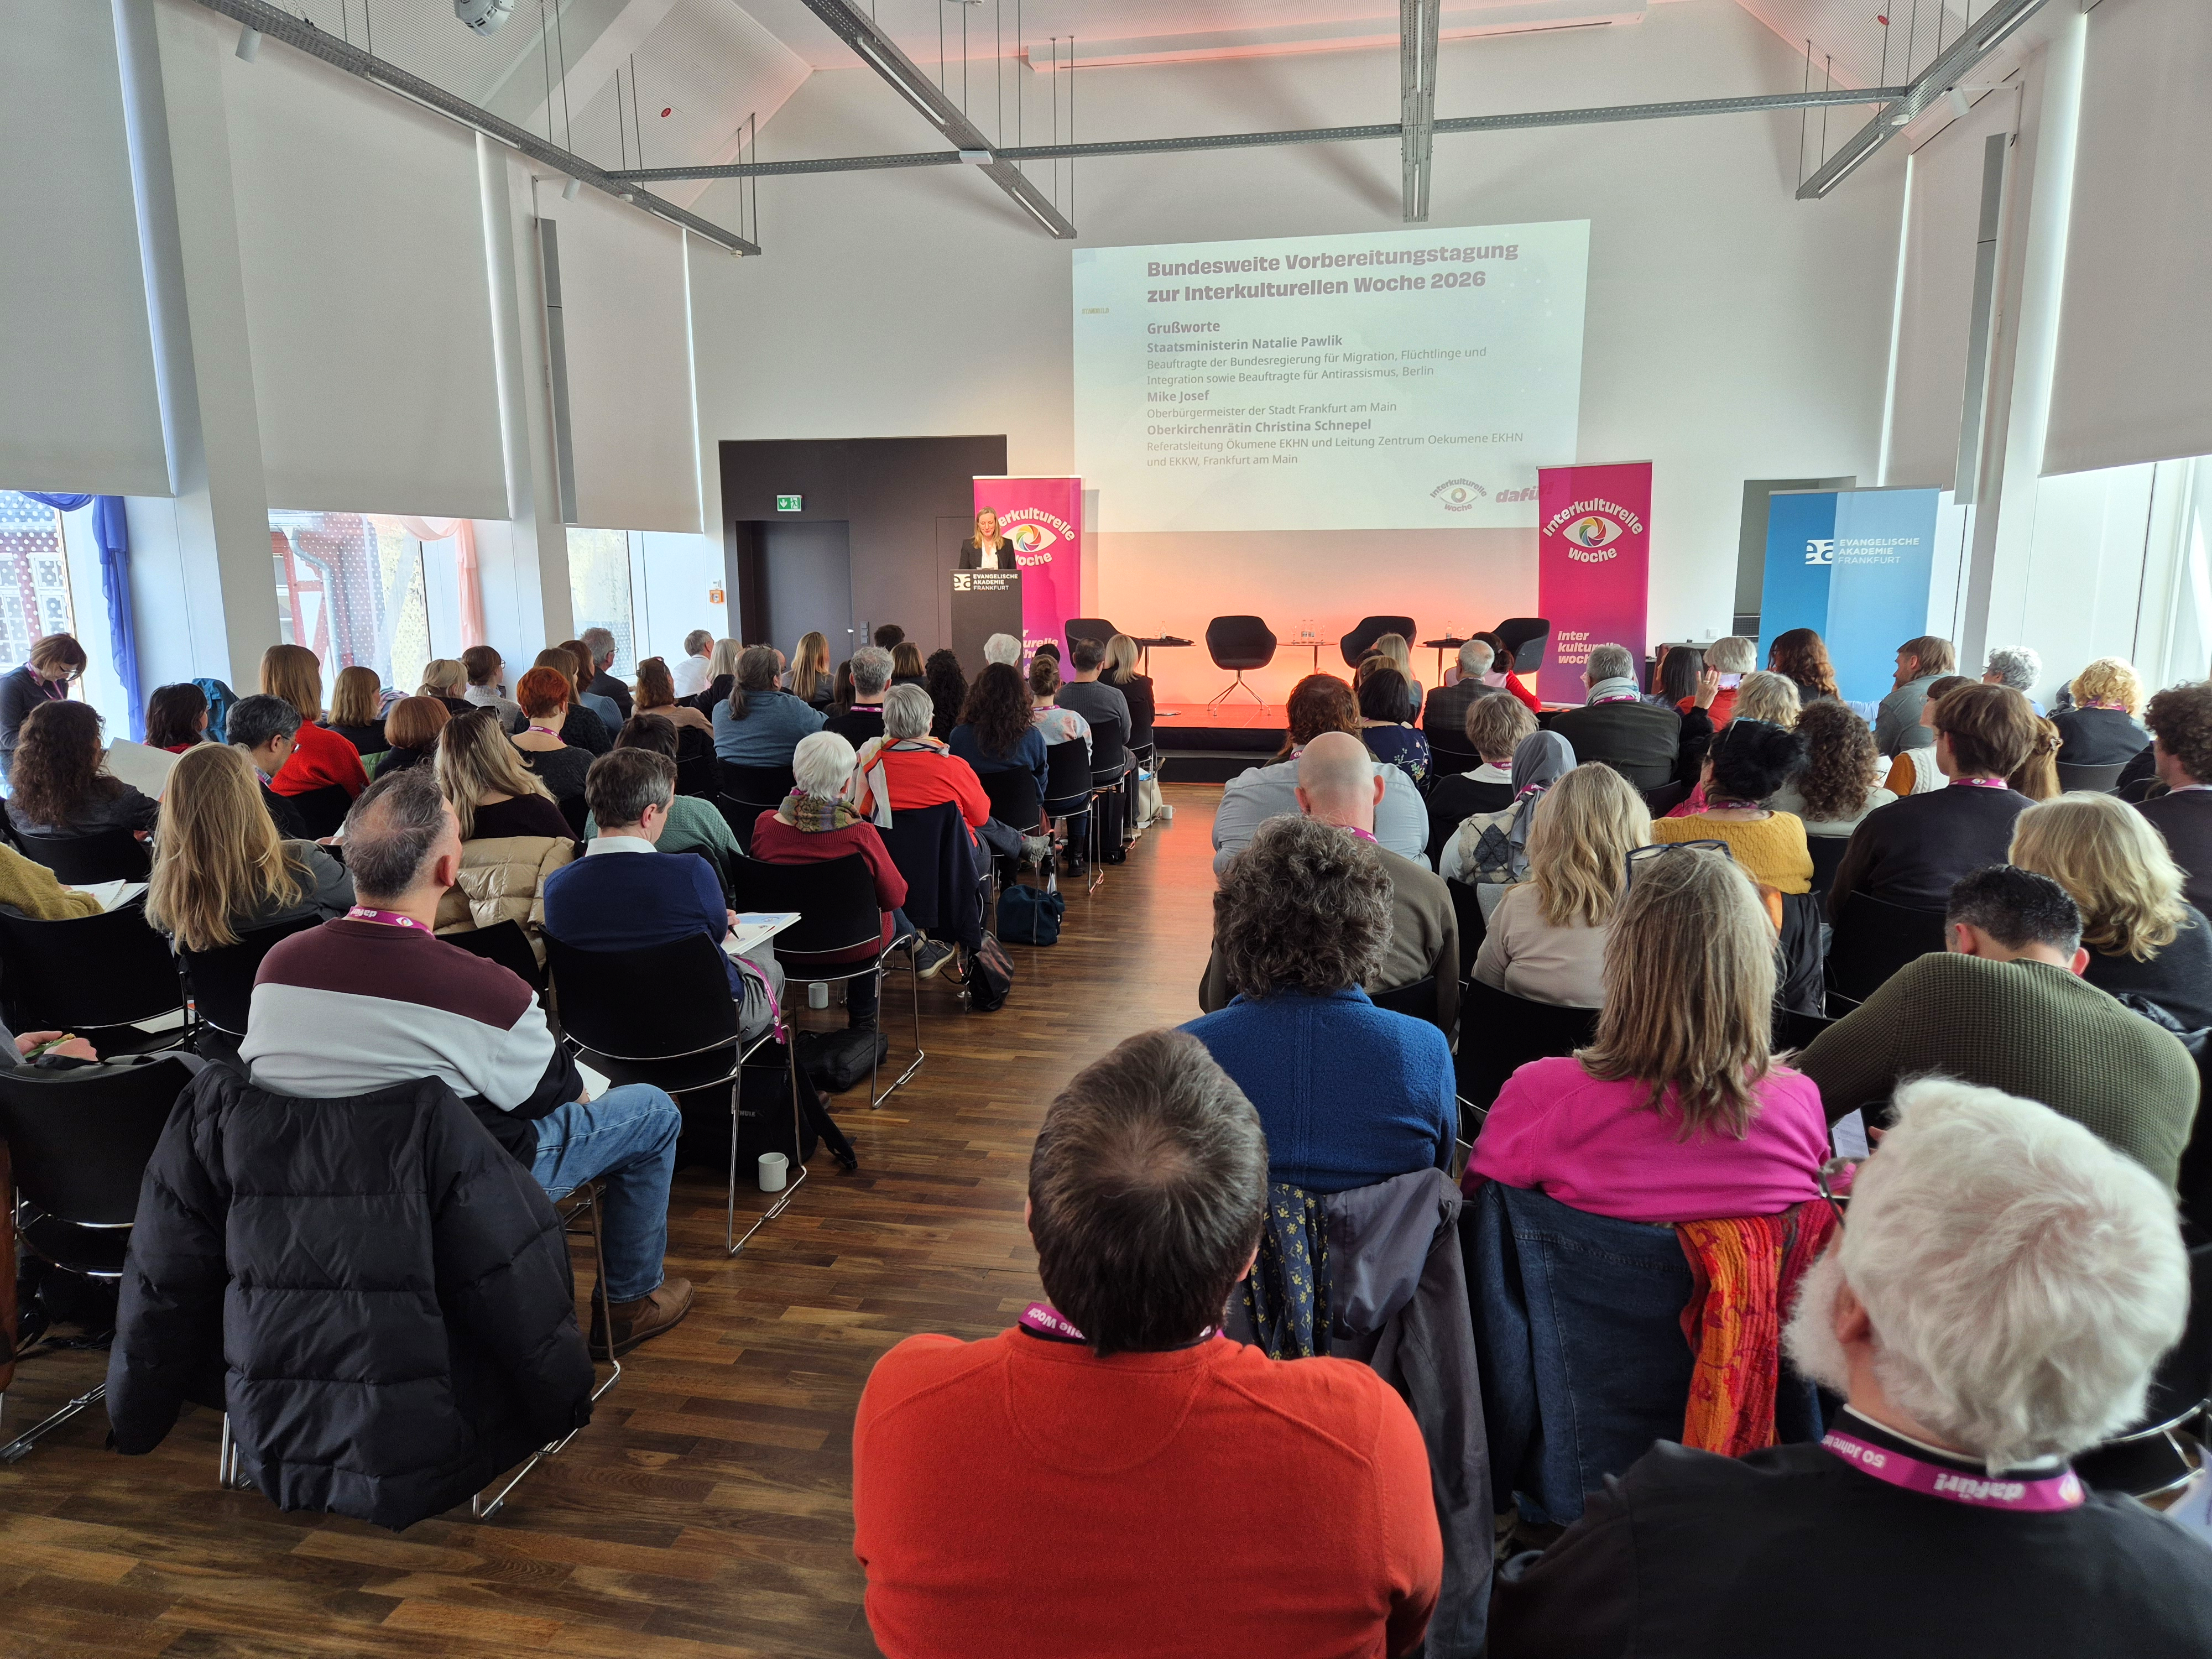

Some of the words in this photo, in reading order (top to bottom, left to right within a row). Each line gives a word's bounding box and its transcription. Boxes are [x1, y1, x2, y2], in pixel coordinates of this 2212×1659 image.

[1147, 257, 1280, 277] Bundesweite
[1285, 244, 1519, 270] Vorbereitungstagung
[1147, 289, 1180, 302] zur
[1185, 279, 1348, 301] Interkulturellen
[1354, 275, 1426, 293] Woche
[1430, 271, 1486, 289] 2026
[1147, 321, 1220, 335] Grußworte
[1147, 339, 1248, 353] Staatsministerin
[1252, 337, 1297, 349] Natalie
[1301, 335, 1343, 347] Pawlik
[1147, 359, 1207, 371] Beauftragte
[1210, 357, 1227, 367] der
[1230, 354, 1321, 367] Bundesregierung
[1324, 353, 1339, 363] für
[1343, 352, 1397, 364] Migration,
[1401, 348, 1462, 360] Flüchtlinge
[1465, 347, 1486, 357] und
[1147, 374, 1203, 387] Integration
[1206, 374, 1235, 383] sowie
[1239, 371, 1300, 383] Beauftragte
[1303, 371, 1318, 380] für
[1321, 367, 1399, 379] Antirassismus,
[1402, 366, 1434, 376] Berlin
[1147, 391, 1176, 402] Mike
[1179, 390, 1209, 404] Josef
[1147, 408, 1245, 419] Oberbürgermeister
[1248, 406, 1266, 416] der
[1269, 405, 1296, 415] Stadt
[1299, 404, 1347, 414] Frankfurt
[1350, 404, 1366, 413] am
[1370, 402, 1397, 411] Main
[1147, 422, 1251, 435] Oberkirchenrätin
[1255, 421, 1311, 432] Christina
[1314, 419, 1371, 432] Schnepel
[1147, 441, 1223, 452] Referatsleitung
[1227, 438, 1276, 450] Ökumene
[1279, 439, 1308, 448] EKHN
[1312, 437, 1332, 447] und
[1335, 437, 1375, 448] Leitung
[1378, 436, 1425, 446] Zentrum
[1428, 434, 1488, 445] Oekumene
[1492, 432, 1523, 442] EKHN
[1147, 457, 1166, 466] und
[1169, 457, 1200, 467] EKKW,
[1203, 455, 1250, 465] Frankfurt
[1253, 456, 1269, 465] am
[1272, 455, 1297, 464] Main
[1430, 478, 1487, 498] Interkulturelle
[998, 507, 1075, 541] erkulturelle
[1542, 498, 1644, 537] Interkulturelle
[1839, 538, 1919, 546] EVANGELISCHE
[1839, 547, 1893, 555] AKADEMIE
[1016, 552, 1052, 566] oche
[1838, 556, 1901, 565] FRANKFURT
[1557, 631, 1590, 641] inter
[1832, 1437, 1863, 1459] Jahre
[1861, 1449, 1887, 1469] 50
[1933, 1473, 2026, 1501] dafür!
